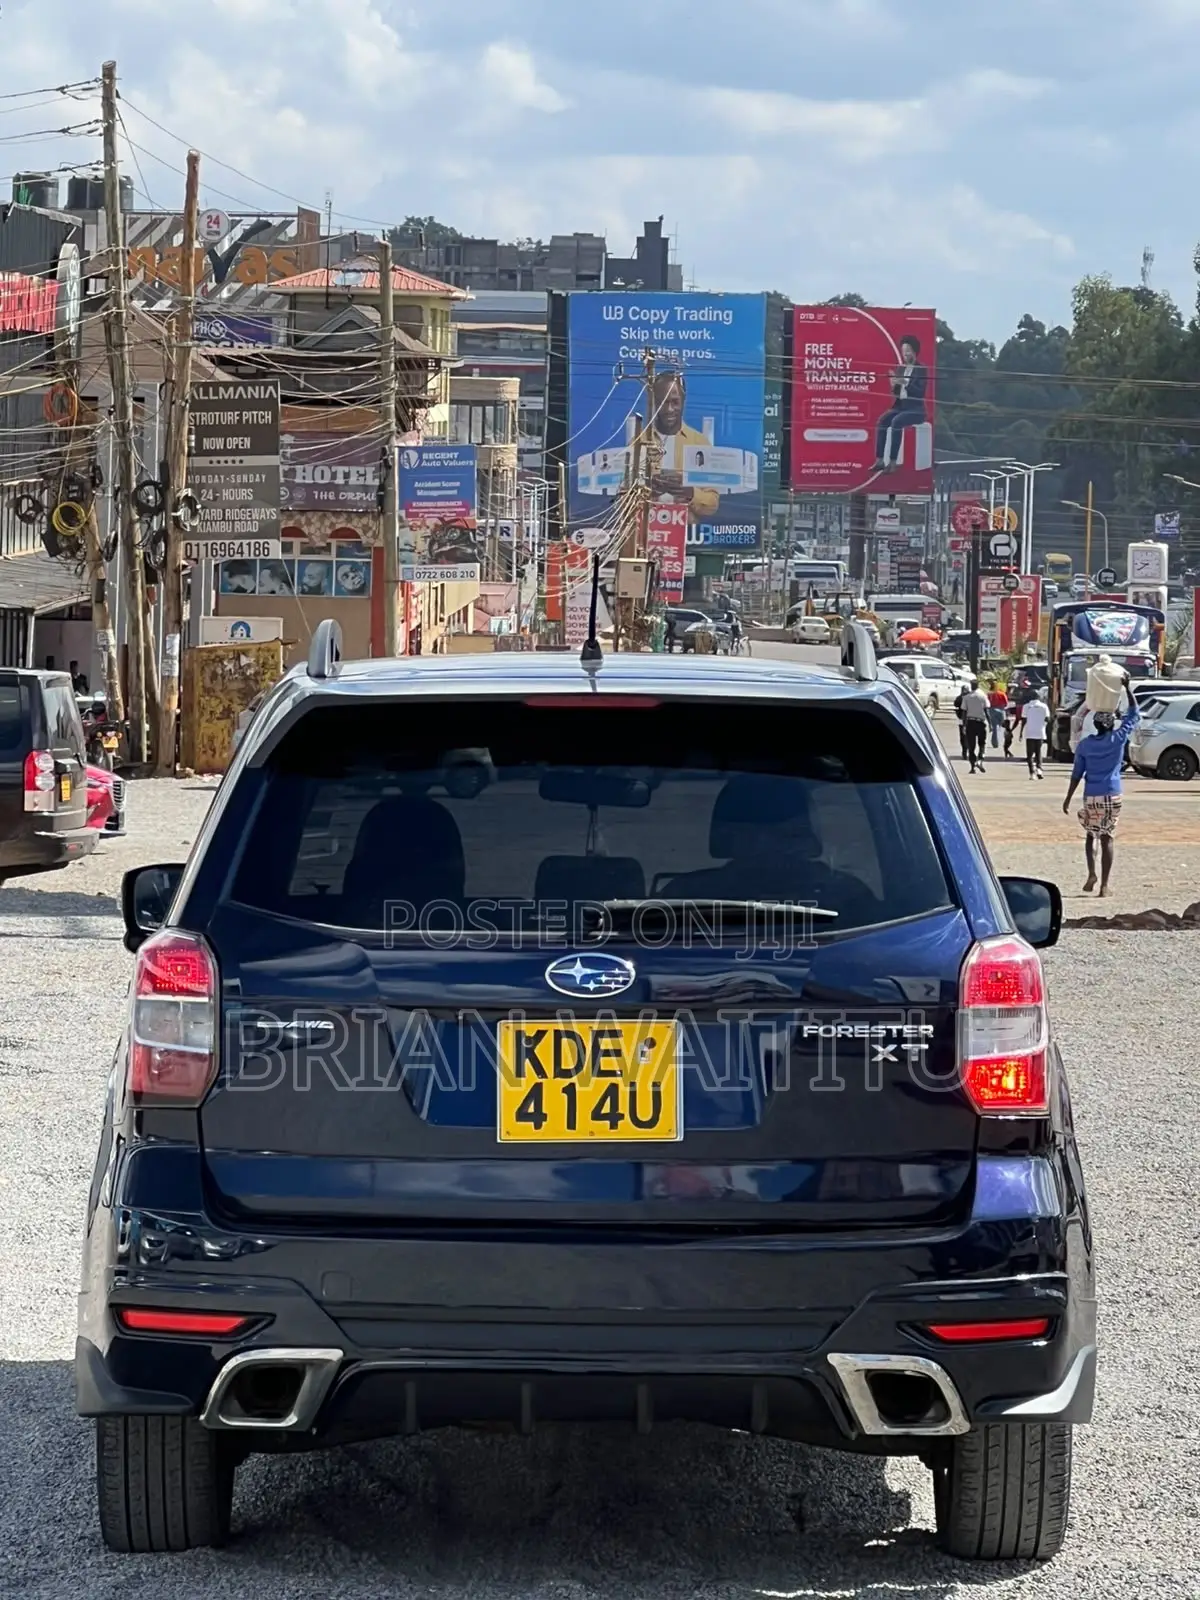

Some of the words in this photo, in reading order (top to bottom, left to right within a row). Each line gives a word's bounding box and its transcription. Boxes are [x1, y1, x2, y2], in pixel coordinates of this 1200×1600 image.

[206, 214, 220, 228] 24
[628, 306, 670, 324] Copy
[674, 306, 733, 324] Trading
[620, 327, 650, 342] Skip
[653, 328, 674, 340] the
[678, 328, 714, 340] work.
[657, 346, 679, 358] the
[682, 349, 716, 360] pros.
[804, 344, 834, 355] FREE
[804, 357, 852, 369] MONEY
[804, 370, 876, 383] TRANSFERS
[242, 410, 272, 424] PITCH
[202, 437, 224, 450] NOW
[226, 436, 251, 450] OPEN
[295, 465, 379, 485] HOTEL
[201, 488, 214, 500] 24
[222, 488, 254, 500] HOURS
[313, 490, 336, 500] THE
[225, 508, 277, 520] RIDGEWAYS
[196, 520, 232, 532] KIAMBU
[234, 520, 259, 532] ROAD
[713, 525, 756, 534] WINDSOR
[714, 534, 756, 544] BROKERS
[184, 541, 270, 558] 0116964186
[460, 570, 475, 578] 210
[802, 1024, 935, 1038] FORESTER
[515, 1029, 624, 1080] KDE
[871, 1044, 929, 1062] XT
[515, 1082, 662, 1130] 414U
